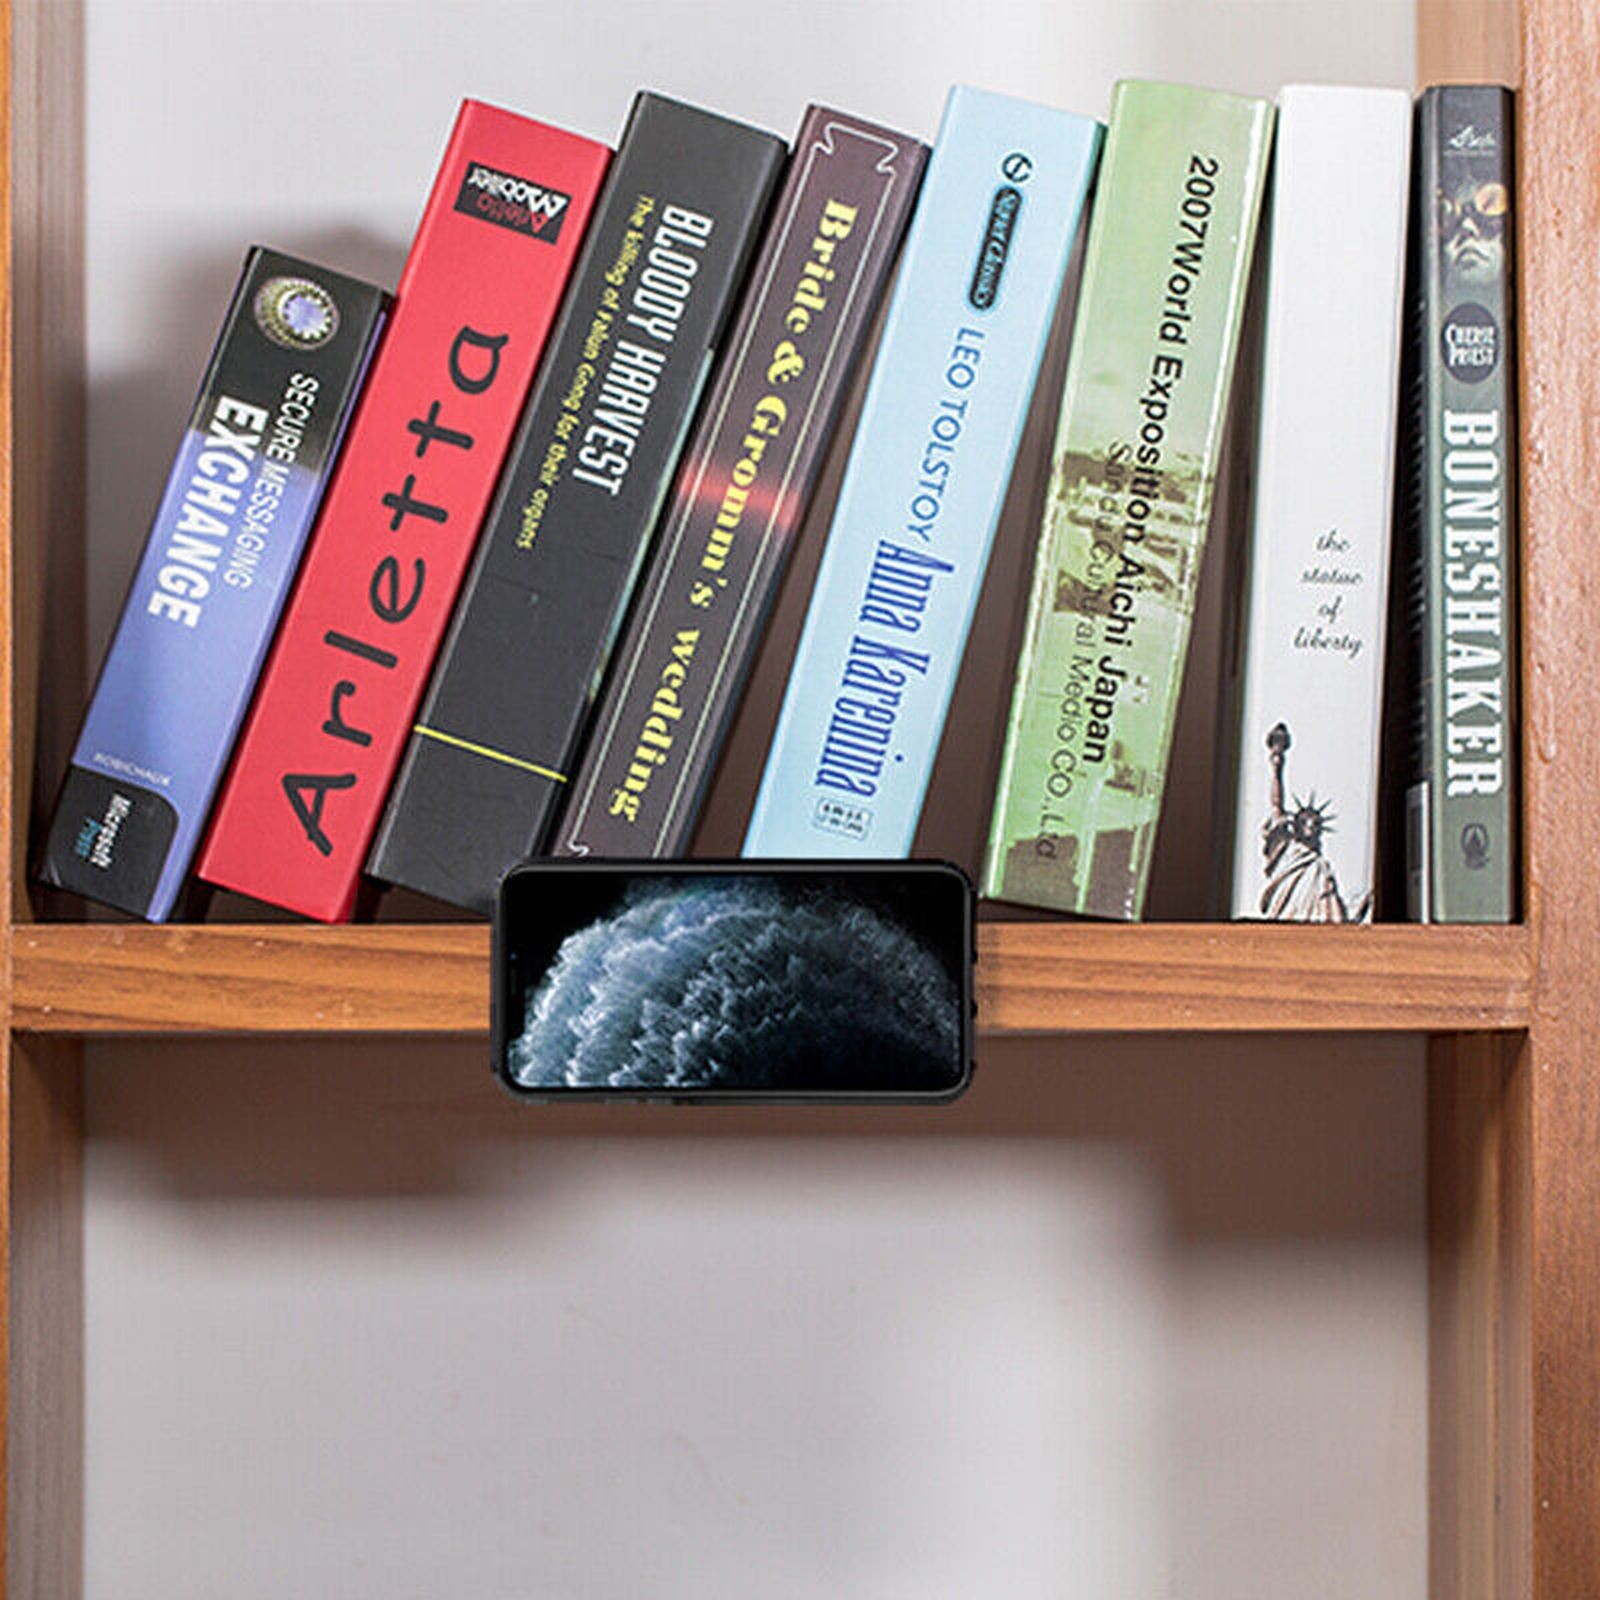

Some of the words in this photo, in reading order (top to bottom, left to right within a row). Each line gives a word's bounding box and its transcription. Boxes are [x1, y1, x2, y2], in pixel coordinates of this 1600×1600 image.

[630, 195, 655, 226] The
[602, 287, 620, 311] of
[605, 231, 644, 287] killing
[626, 205, 714, 343] BLOODY
[785, 198, 859, 334] Bride
[767, 340, 805, 384] &
[946, 327, 985, 388] LEO
[266, 373, 319, 463] SECURE
[539, 442, 567, 487] their
[555, 413, 580, 441] for
[572, 340, 666, 496] HARVEST
[1122, 356, 1183, 544] Exposition
[147, 396, 270, 628] EXCHANGE
[907, 400, 968, 543] TOLSTOY
[223, 461, 289, 589] MESSAGING
[516, 487, 549, 551] organs
[1315, 529, 1349, 551] the
[281, 326, 509, 857] Arletta
[858, 539, 955, 633] Anna
[1104, 553, 1145, 647] Aichi
[1299, 569, 1364, 586] statue
[1318, 595, 1343, 623] of
[1443, 410, 1503, 797] BONESHAKER
[1293, 627, 1363, 659] liberty
[609, 629, 700, 822] wedding
[814, 635, 931, 798] Karenina
[1083, 656, 1127, 763] Japan
